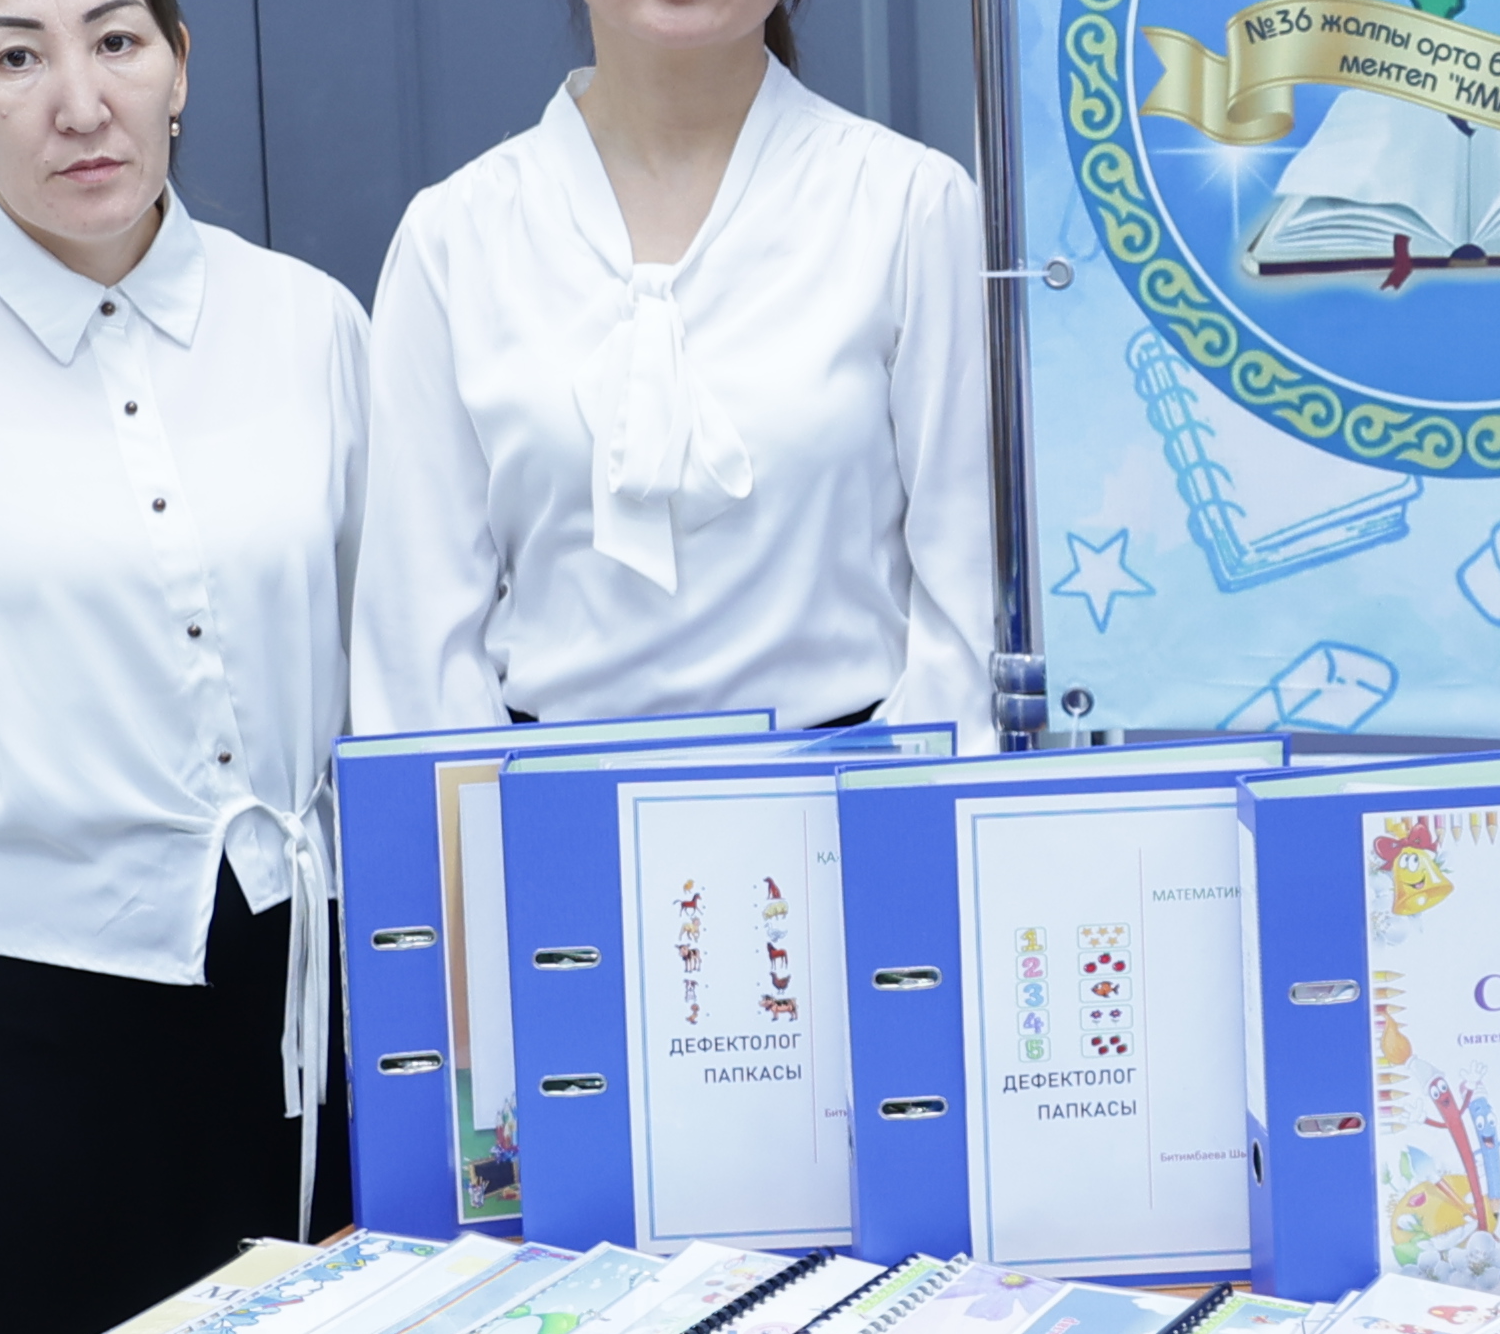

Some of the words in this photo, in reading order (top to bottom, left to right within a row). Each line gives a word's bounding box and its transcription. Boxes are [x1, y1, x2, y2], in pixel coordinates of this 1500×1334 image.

[1244, 5, 1315, 44] №36
[1320, 13, 1411, 55] жалпы
[1417, 32, 1482, 71] орта
[1339, 53, 1438, 95] мектеп
[669, 1032, 802, 1057] ДЕФЕКТОЛОГ
[703, 1063, 803, 1085] ПАПКАСЫ
[1002, 1067, 1137, 1095] ДЕФЕКТОЛОГ
[1037, 1099, 1138, 1121] ПАПКАСЫ
[1160, 1149, 1227, 1165] Битимбаева
